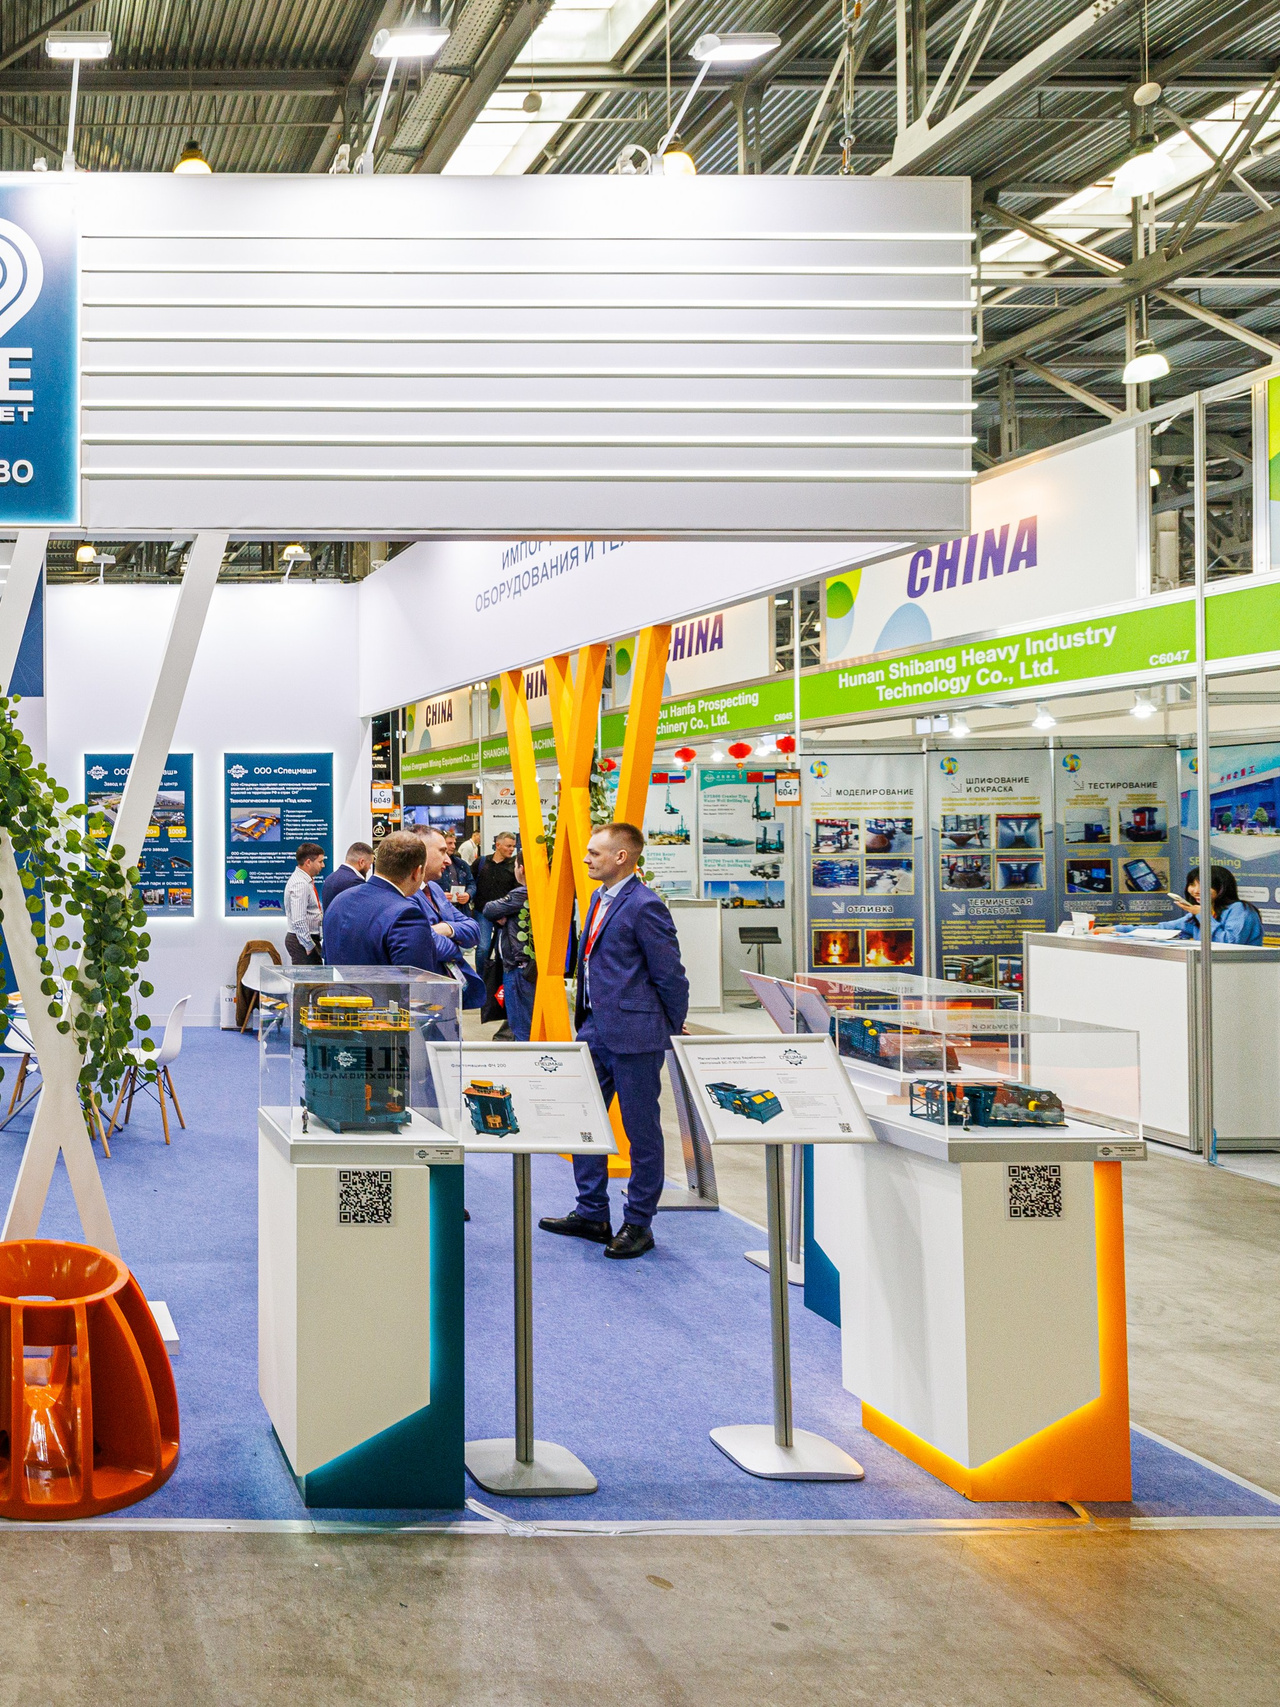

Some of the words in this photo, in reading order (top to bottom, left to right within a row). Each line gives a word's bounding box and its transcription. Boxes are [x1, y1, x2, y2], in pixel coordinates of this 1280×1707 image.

[906, 515, 1038, 599] CHINA
[475, 546, 580, 612] ОБОРУДОВАНИЯ
[584, 541, 595, 563] И
[667, 614, 724, 663] HINA
[838, 669, 885, 690] Hunan
[888, 654, 957, 681] Shibang
[961, 643, 1020, 669] Heavy
[1025, 626, 1118, 656] Industry
[1149, 649, 1190, 666] C6047
[524, 669, 548, 700] HIN
[876, 674, 971, 703] Technology
[976, 666, 1014, 687] Co.,
[1019, 659, 1059, 680] Ltd.
[425, 698, 454, 728] CHINA
[670, 702, 696, 716] Hanfa
[698, 692, 759, 712] Prospecting
[656, 721, 688, 735] chinery
[690, 716, 709, 730] Co.,
[711, 712, 730, 726] Ltd.
[532, 738, 556, 750] ACHINE
[273, 767, 317, 775] «Спецмаш»
[778, 788, 798, 796] 6047
[1210, 858, 1242, 869] ining
[968, 898, 1033, 907] ТЕРМИЧЕСКАЯ
[968, 907, 1021, 915] ОБРАБОТКА
